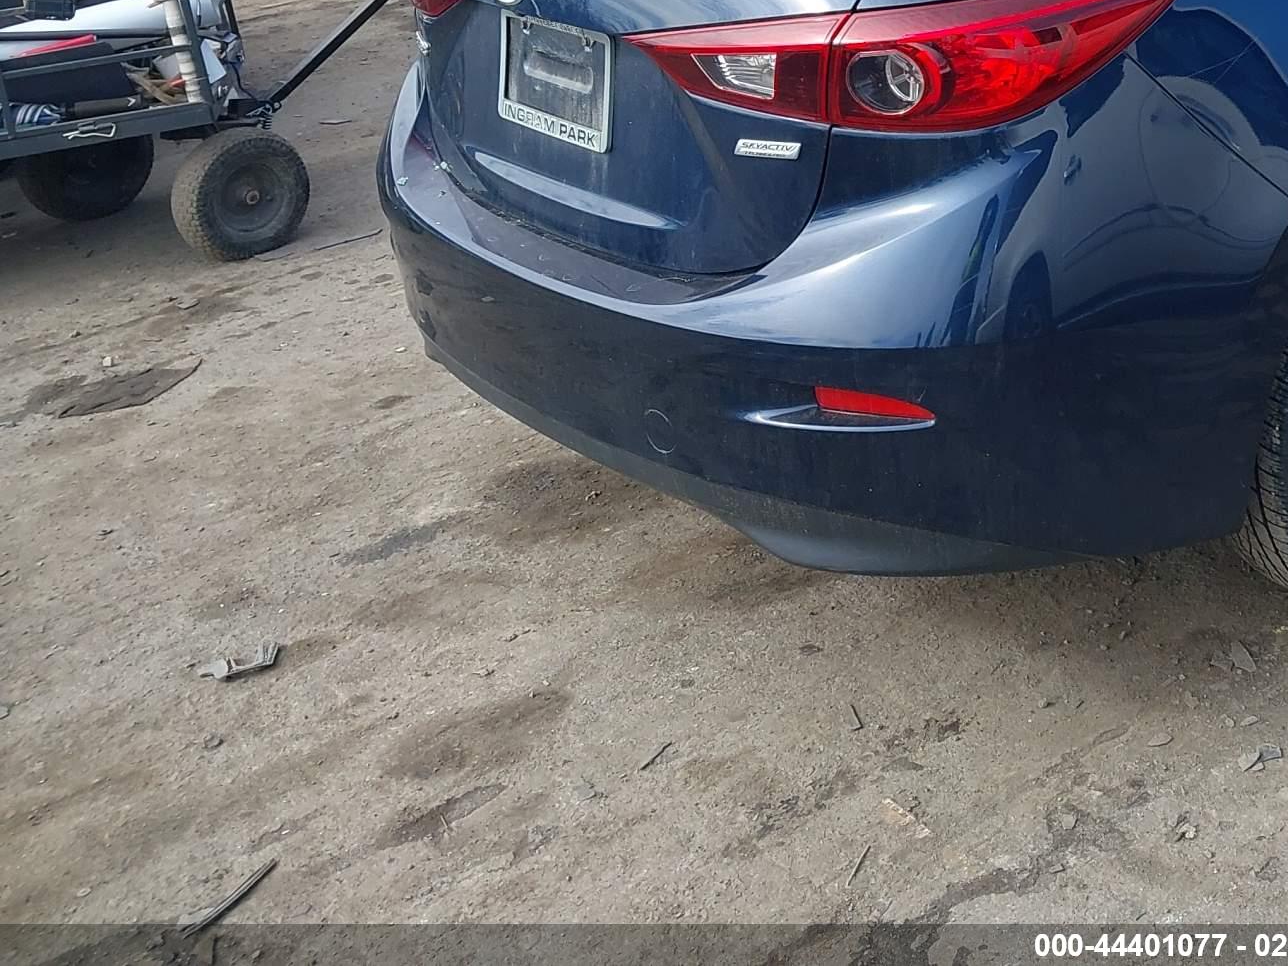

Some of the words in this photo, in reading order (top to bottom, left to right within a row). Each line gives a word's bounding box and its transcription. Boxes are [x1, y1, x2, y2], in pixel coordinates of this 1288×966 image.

[503, 102, 556, 133] INGRAM
[559, 123, 597, 148] PARK
[741, 141, 797, 152] SKYACTIV
